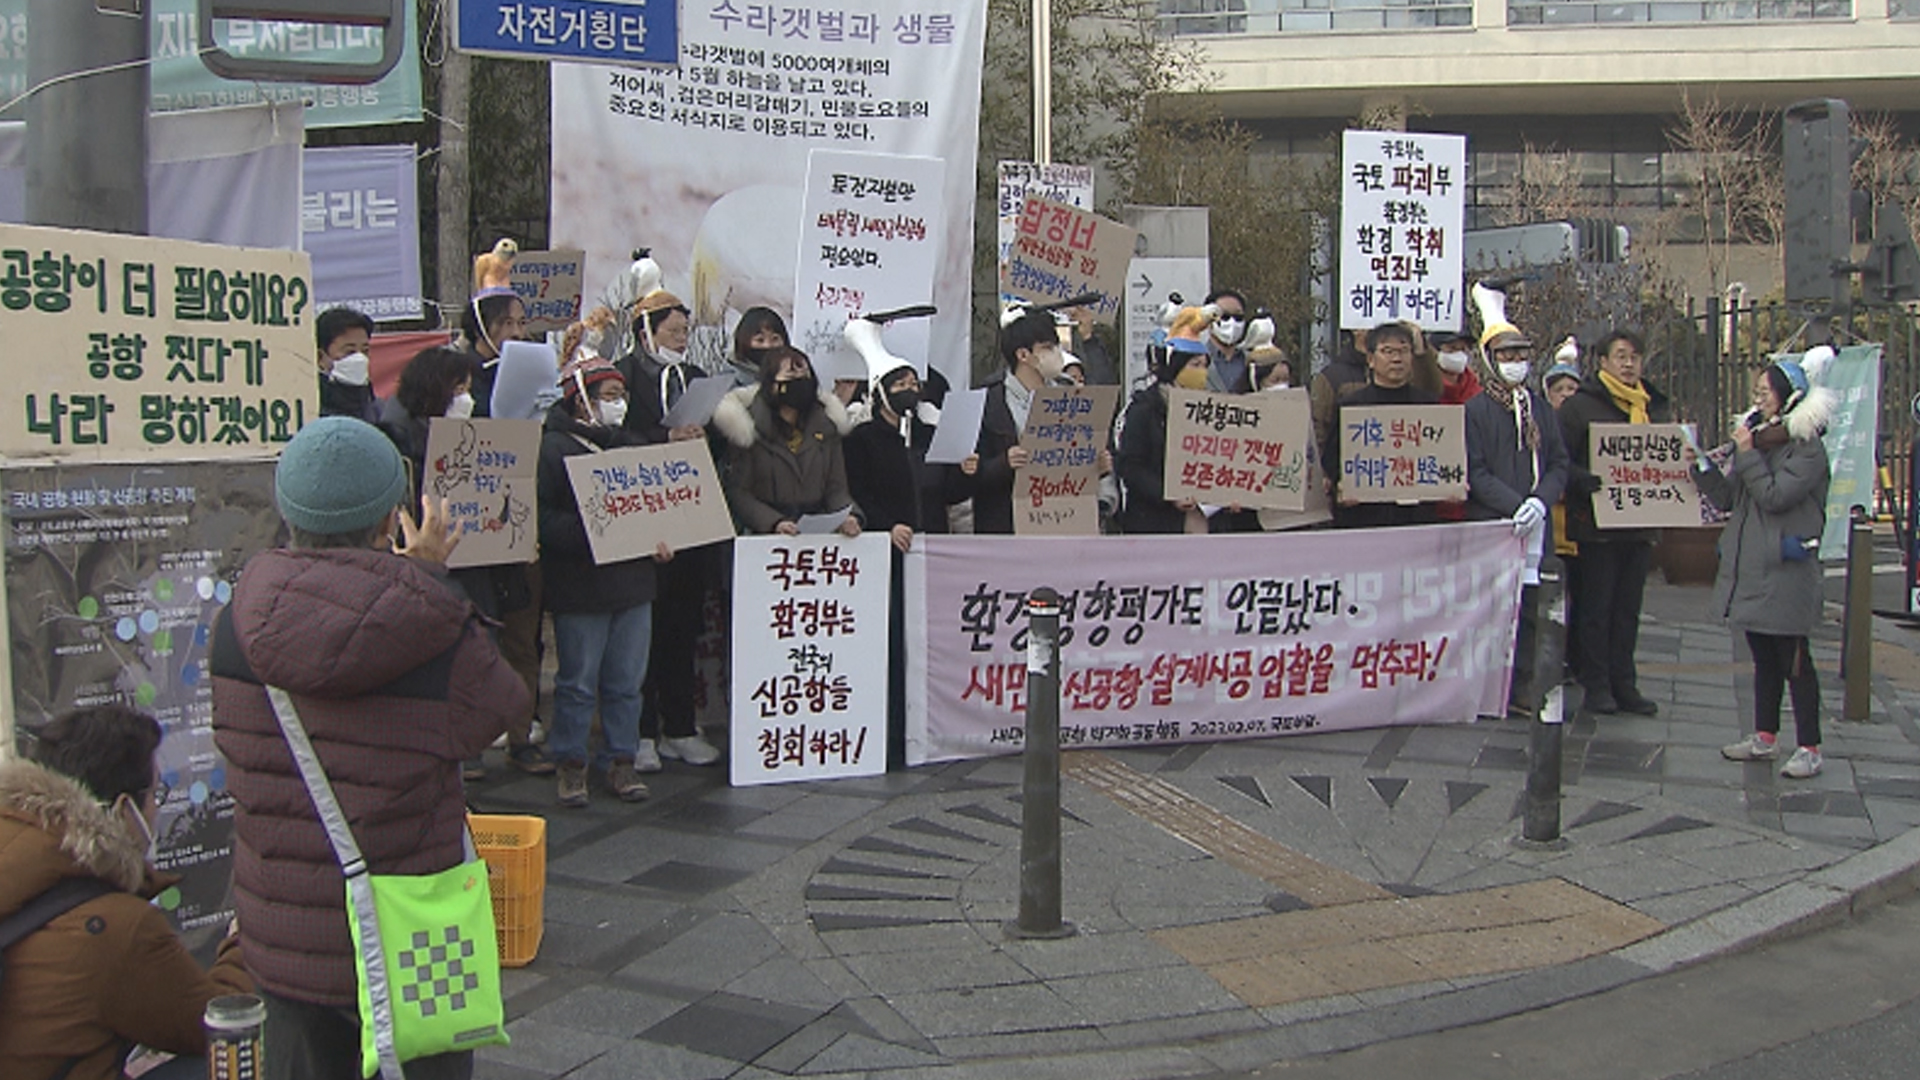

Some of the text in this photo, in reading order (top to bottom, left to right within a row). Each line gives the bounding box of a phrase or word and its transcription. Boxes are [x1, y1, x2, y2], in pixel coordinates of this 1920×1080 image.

[497, 5, 647, 52] 자전거횡단
[709, 3, 956, 45] 수라갯벌과 생물
[683, 44, 765, 68] 라갯벌에
[609, 72, 665, 98] 저어새
[690, 68, 719, 85] 5월
[726, 70, 781, 92] 하늘을
[832, 80, 873, 98] 있다.
[609, 93, 875, 140] 중요한 서식지로 이용되고 있다.
[1381, 140, 1425, 162] 국토부는
[831, 173, 917, 204] 토건자본만
[1352, 163, 1454, 197] 국토 파괴부
[1382, 201, 1429, 225] 환경부는
[1357, 224, 1445, 259] 환경 착취
[1371, 255, 1429, 283] 면죄부
[0, 249, 309, 326] 공항이 더 필요해요?
[1351, 284, 1400, 319] 해체
[1405, 287, 1456, 322] 하라!
[86, 332, 148, 381] 공항
[25, 393, 115, 445] 나라
[1347, 416, 1385, 449] 기후
[1181, 434, 1284, 468] 마지막 갯벌
[1598, 433, 1683, 463] 새만금신공항
[1181, 461, 1275, 494] 보존하라!
[1344, 453, 1389, 489] 마지막
[765, 546, 860, 591] 국토부와
[769, 597, 856, 640] 환경부는
[1225, 578, 1359, 636] 안끝났다.
[787, 643, 834, 675] 전국의
[1350, 636, 1449, 690] 멈추라!
[750, 674, 853, 718] 신공항들
